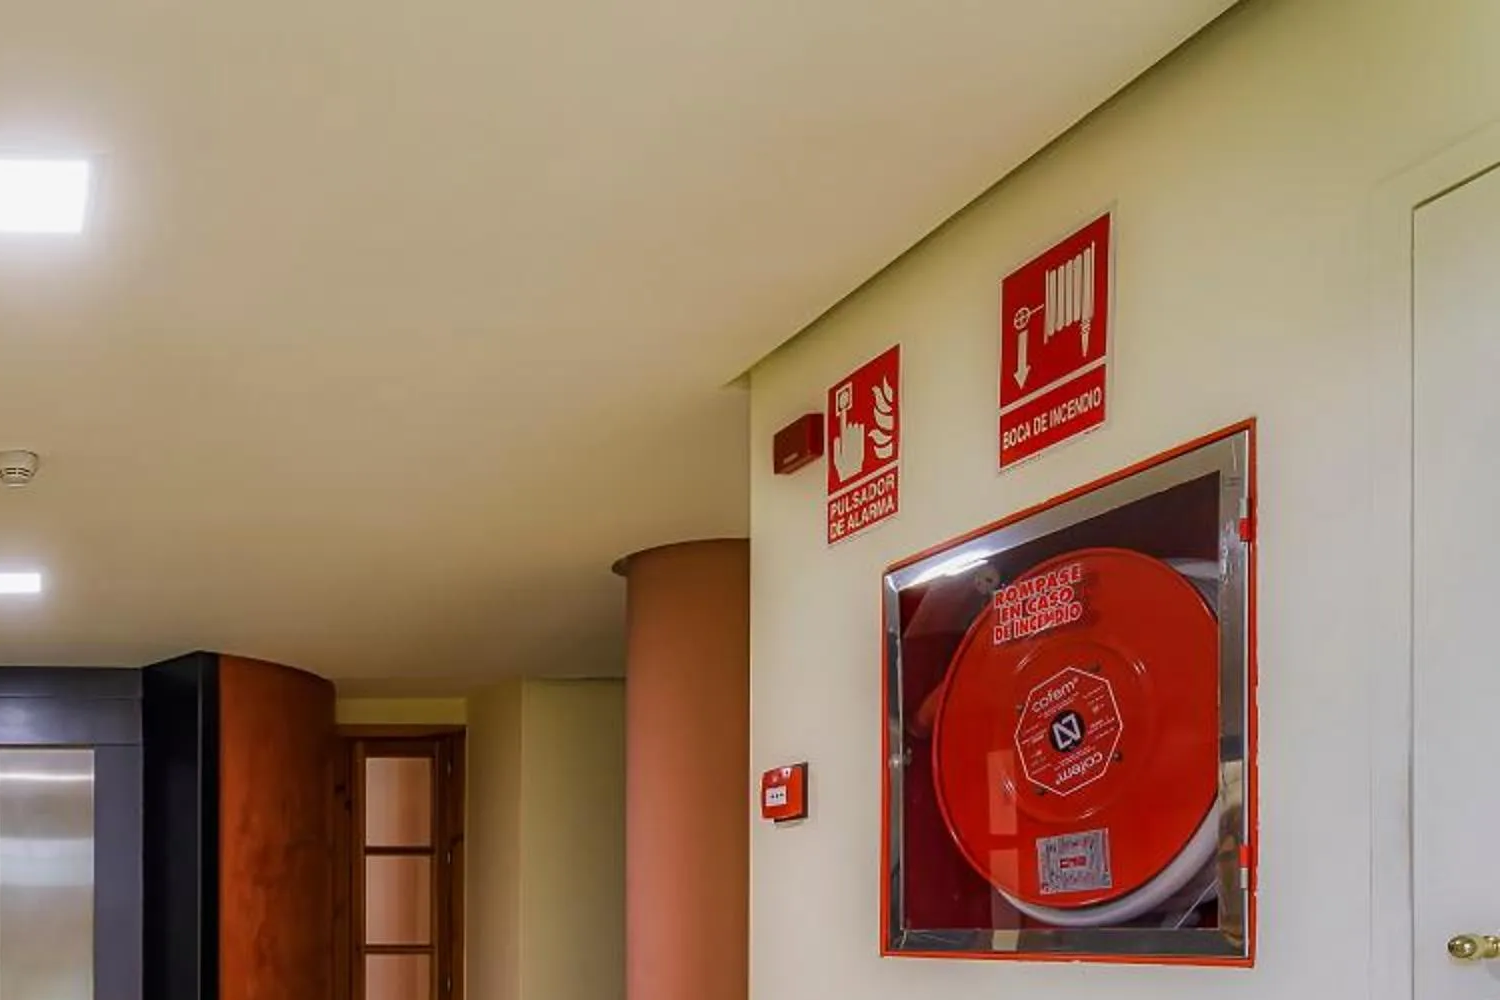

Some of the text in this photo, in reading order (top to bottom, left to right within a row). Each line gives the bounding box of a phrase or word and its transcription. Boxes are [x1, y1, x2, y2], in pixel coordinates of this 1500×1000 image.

[1003, 387, 1102, 450] BOCA DE INCENDIO
[829, 474, 895, 520] PULSADOR
[829, 494, 896, 539] DE ALARMA
[993, 562, 1082, 610] ROMPASE
[1000, 585, 1074, 626] EN CASO
[993, 601, 1083, 645] DE INCENDIO
